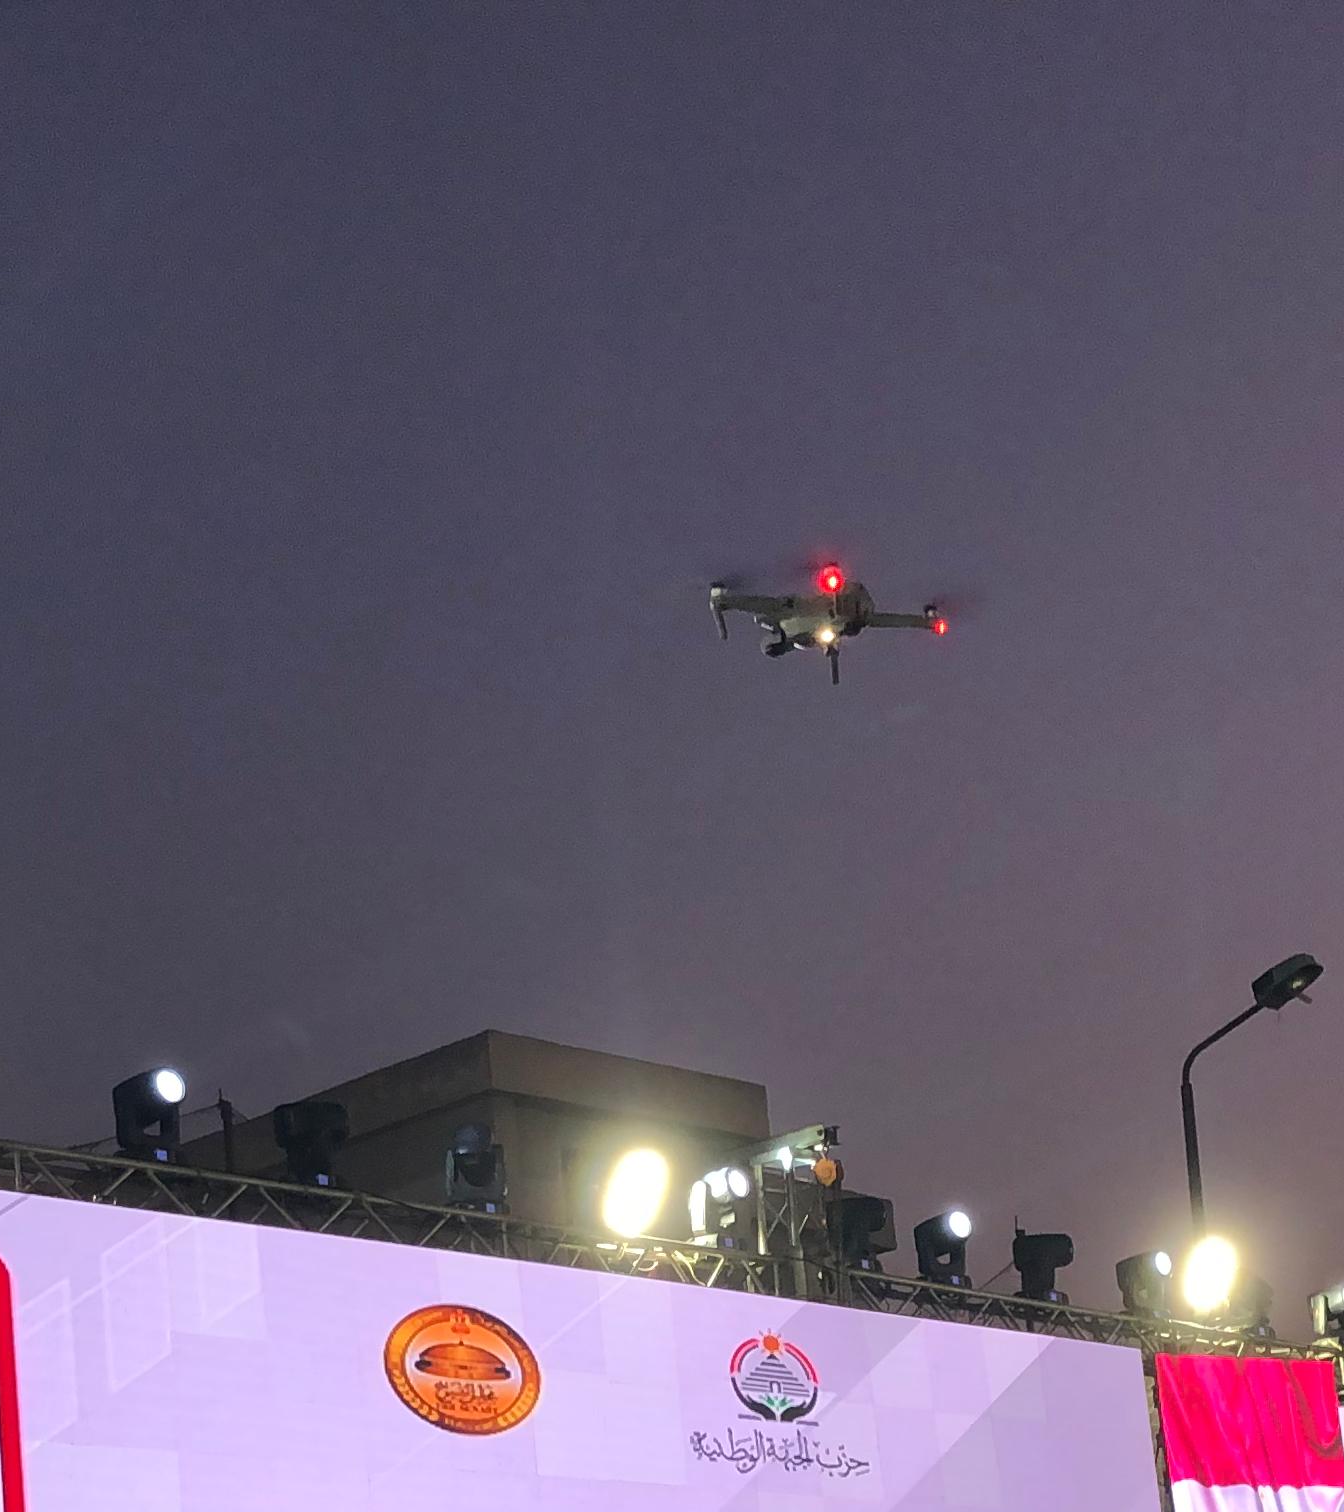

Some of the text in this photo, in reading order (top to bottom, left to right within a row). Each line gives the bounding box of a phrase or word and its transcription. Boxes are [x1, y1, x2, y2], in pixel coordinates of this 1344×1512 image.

[690, 1427, 870, 1478] حزب الجبهة الوطنية
